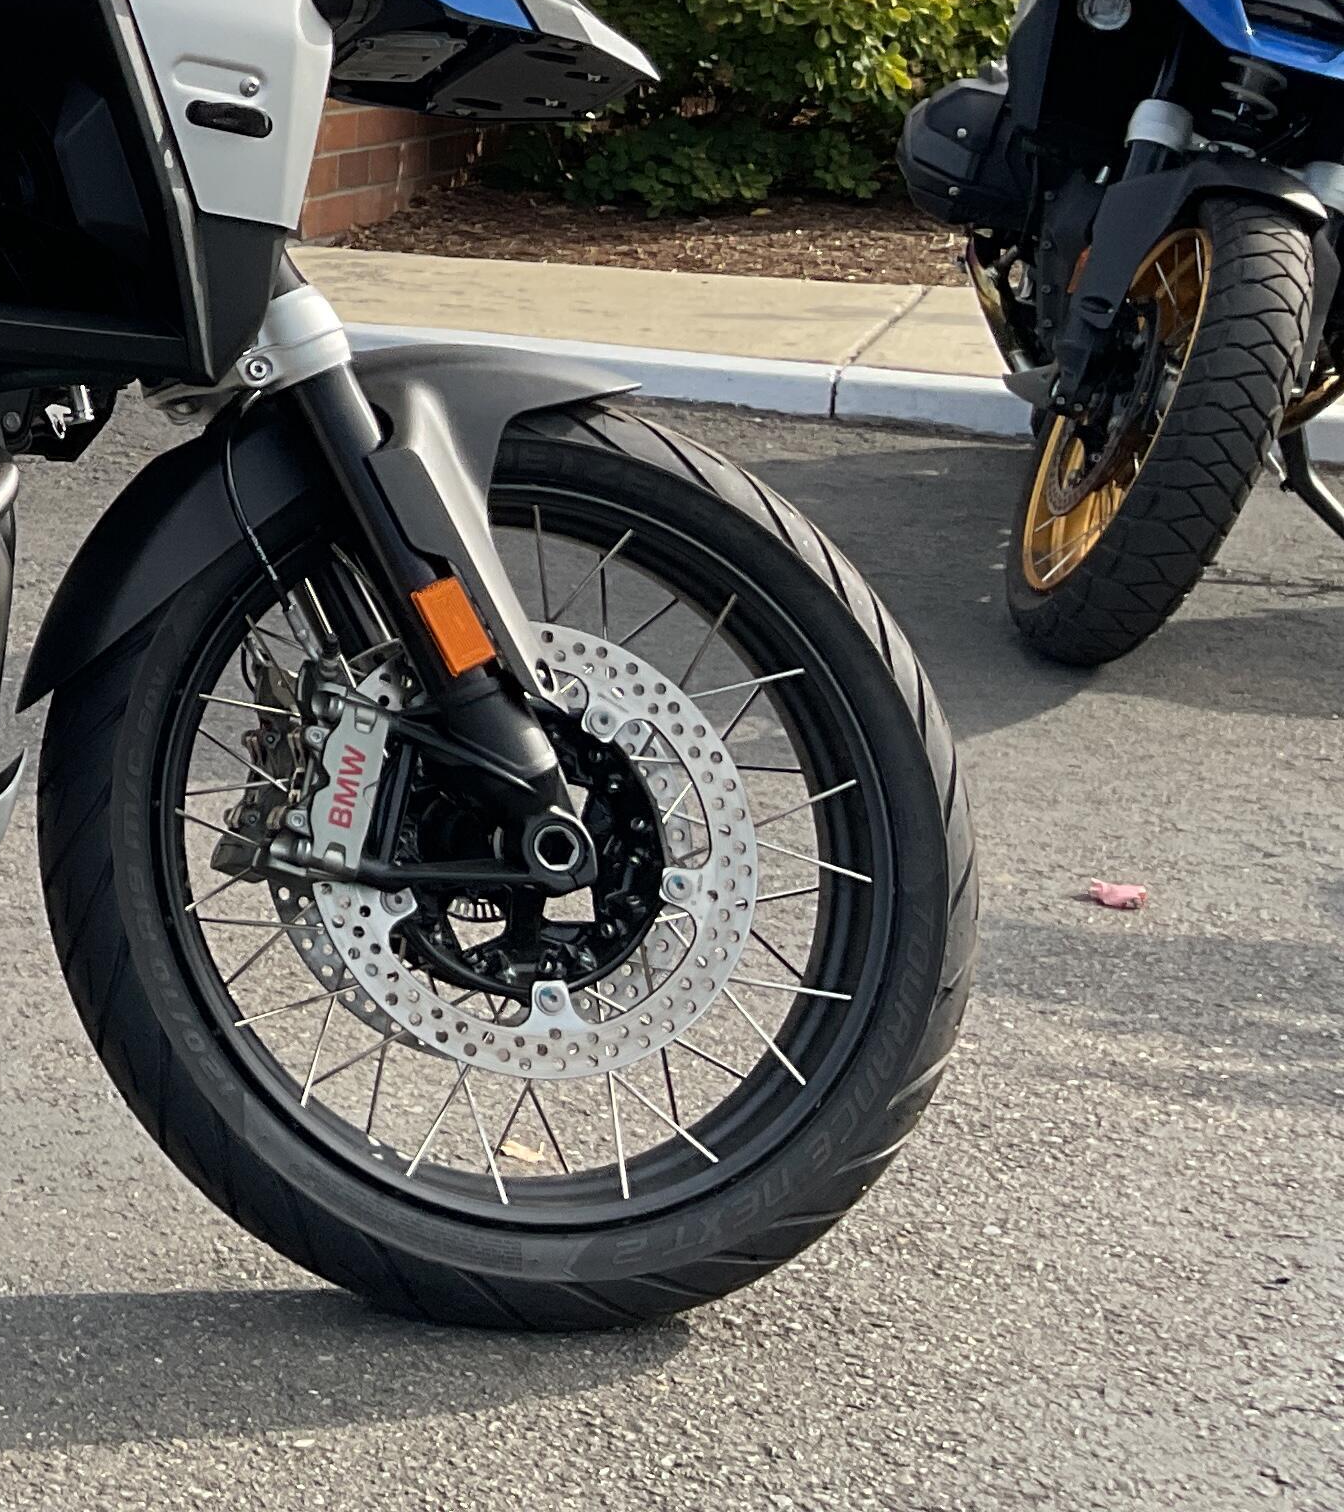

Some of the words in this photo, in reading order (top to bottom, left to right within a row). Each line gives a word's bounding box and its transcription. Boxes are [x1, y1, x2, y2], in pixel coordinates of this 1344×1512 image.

[328, 744, 367, 829] BMW
[804, 904, 935, 1173] TOURANCE
[612, 1231, 650, 1266] 2
[662, 1168, 790, 1257] NEXT
